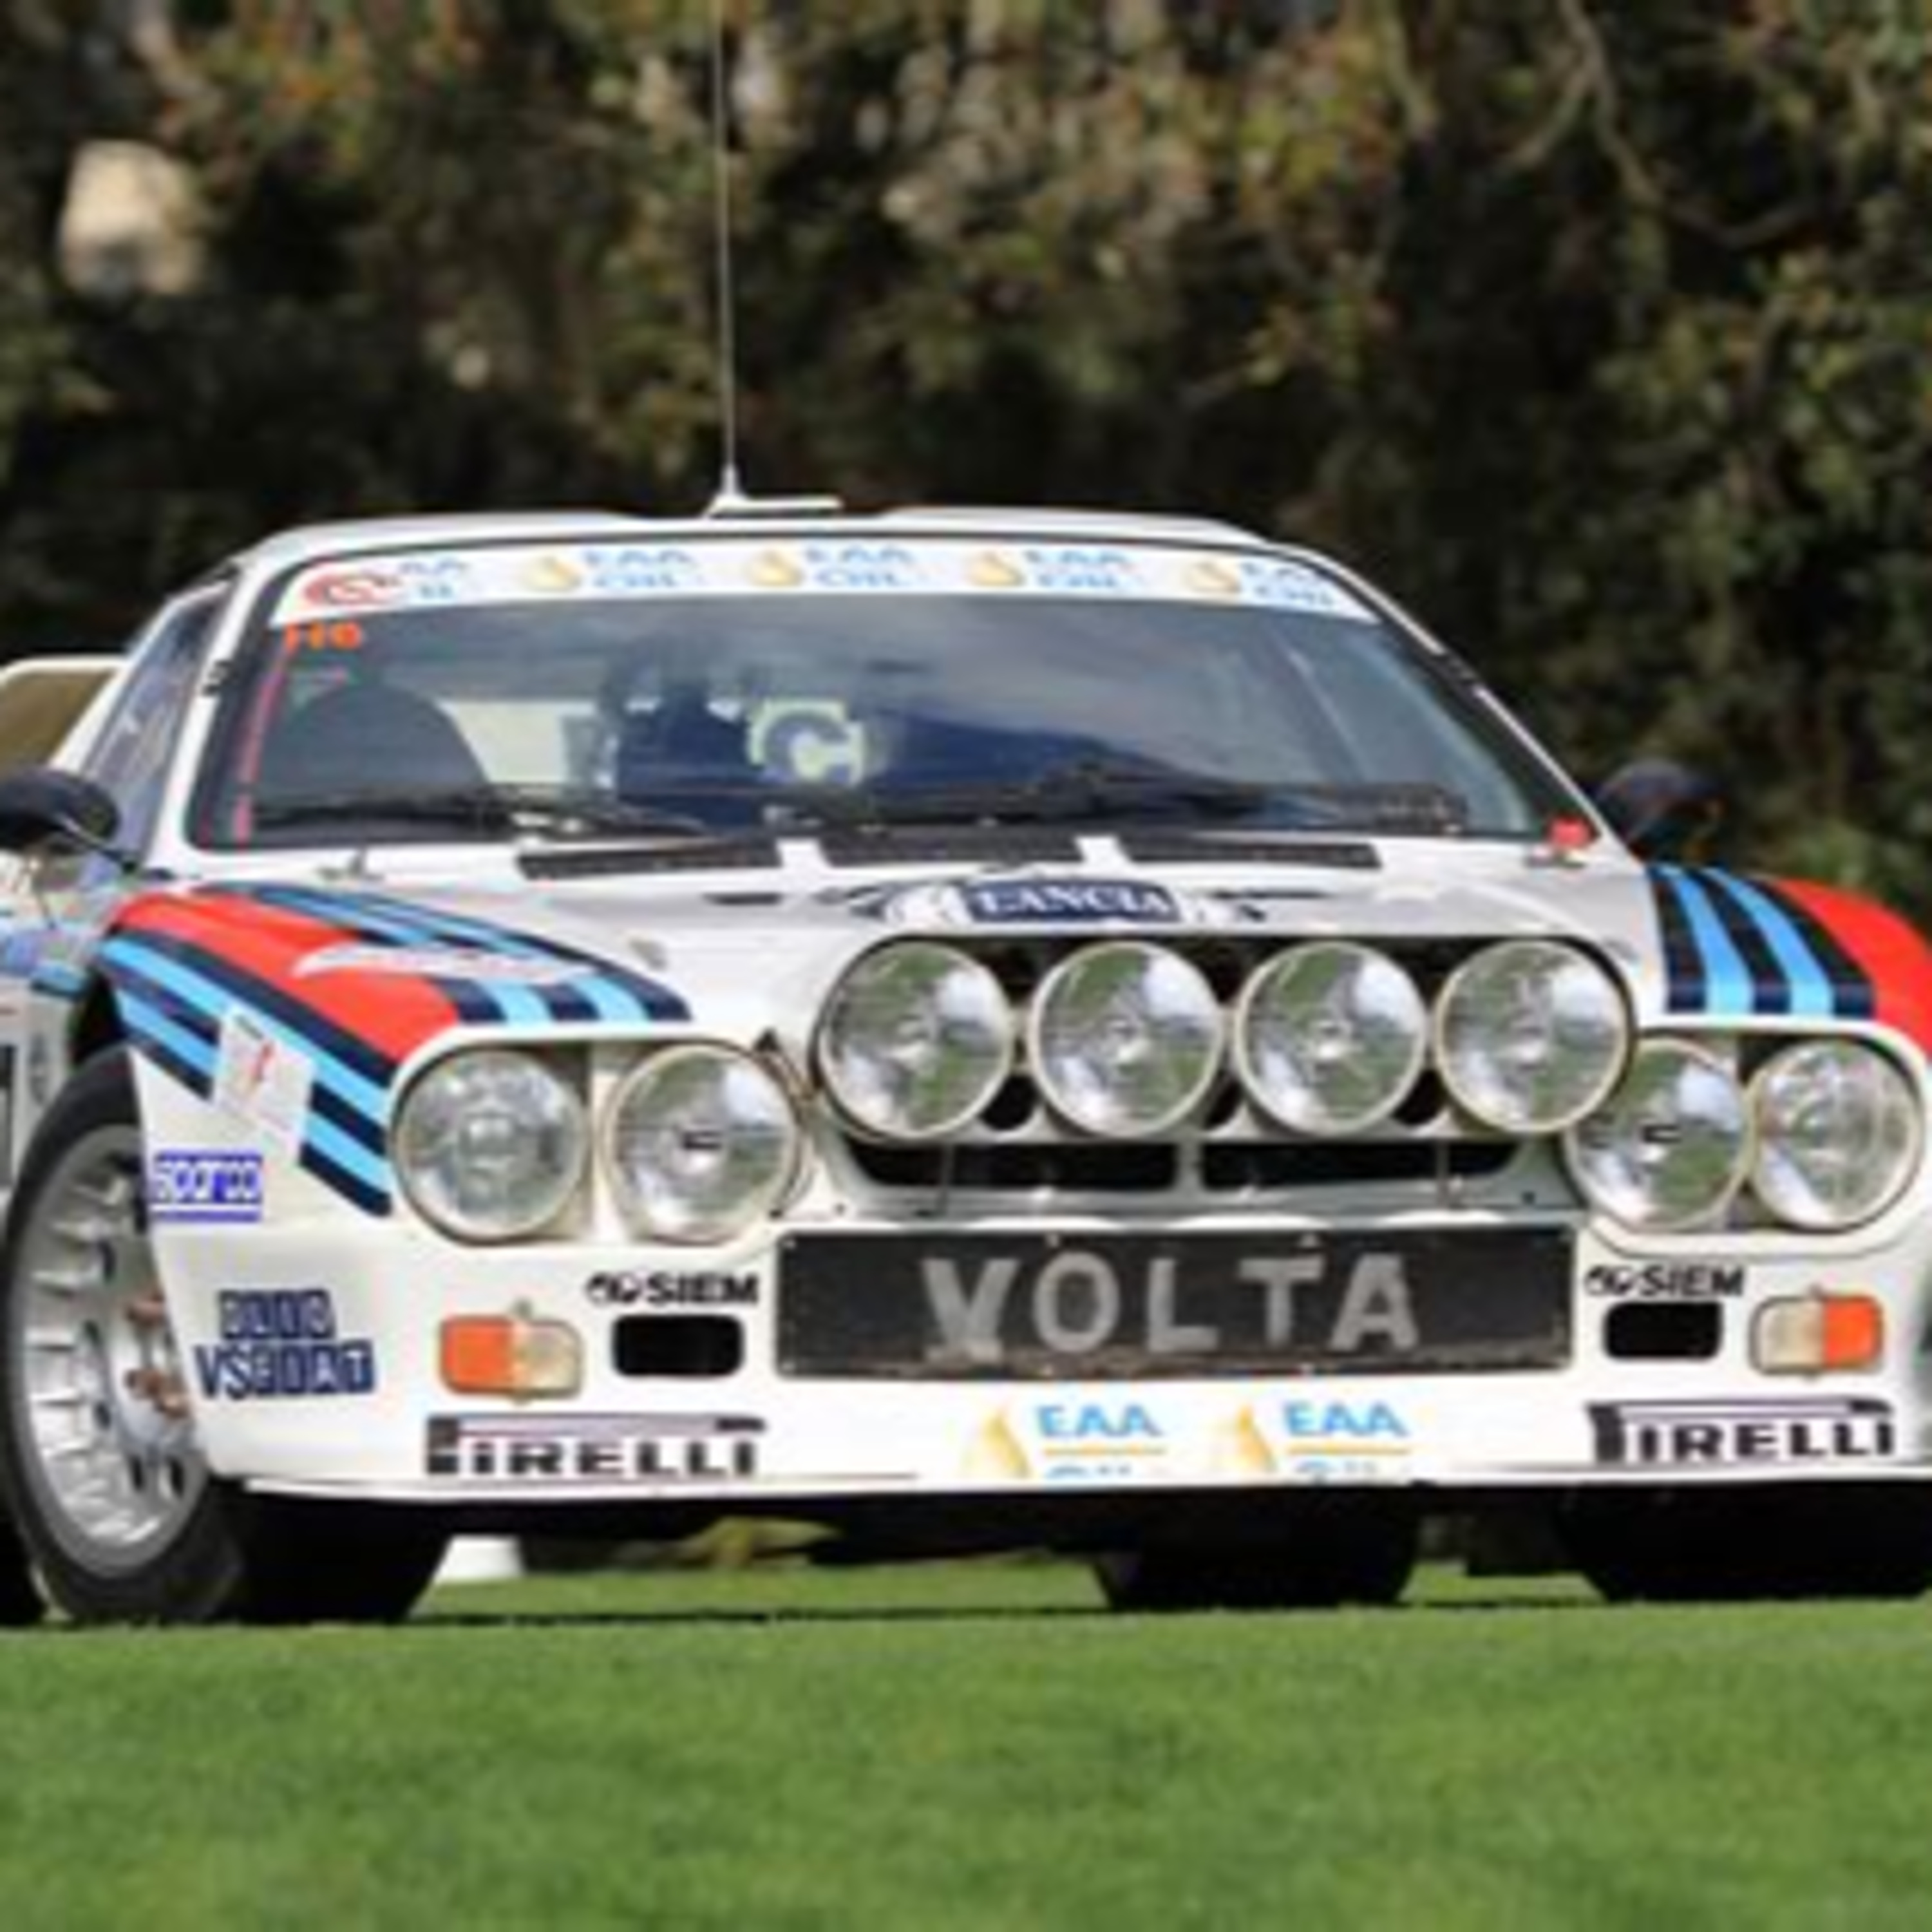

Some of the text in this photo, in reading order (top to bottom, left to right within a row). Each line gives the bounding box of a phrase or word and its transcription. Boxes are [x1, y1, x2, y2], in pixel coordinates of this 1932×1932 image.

[975, 885, 1173, 914] LANCIA
[921, 1251, 1421, 1364] VOLTA
[1036, 1404, 1164, 1440] EAA
[1280, 1401, 1409, 1437] EAA
[1586, 1396, 1895, 1463] PIRELLI
[425, 1413, 765, 1476] PIRELLI
